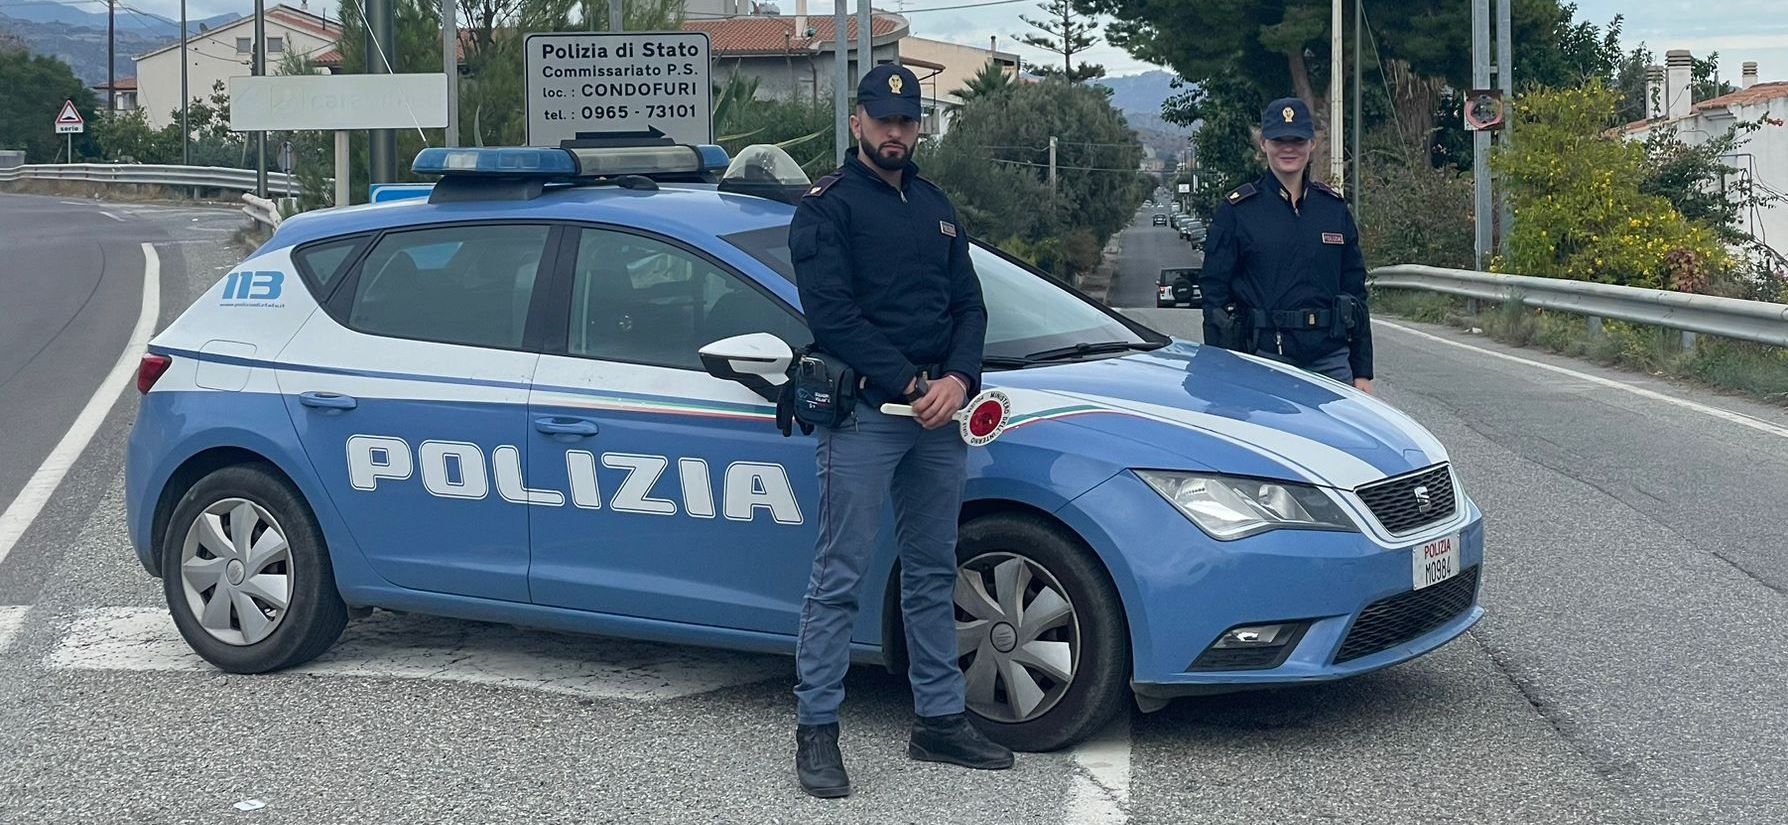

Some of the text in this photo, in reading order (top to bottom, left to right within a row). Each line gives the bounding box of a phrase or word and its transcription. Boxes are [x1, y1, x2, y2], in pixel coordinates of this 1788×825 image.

[542, 42, 699, 59] Polizia di Stato
[542, 63, 698, 78] Commissariato P.S.
[543, 87, 567, 98] loc.
[581, 82, 696, 97] CONDOFURI
[544, 110, 567, 120] tel.
[581, 106, 629, 119] 0965
[645, 104, 696, 118] 73101
[222, 271, 285, 299] 113
[346, 434, 804, 525] POLIZIA
[1424, 538, 1451, 560] POLIZIA
[1425, 555, 1451, 586] M0984
